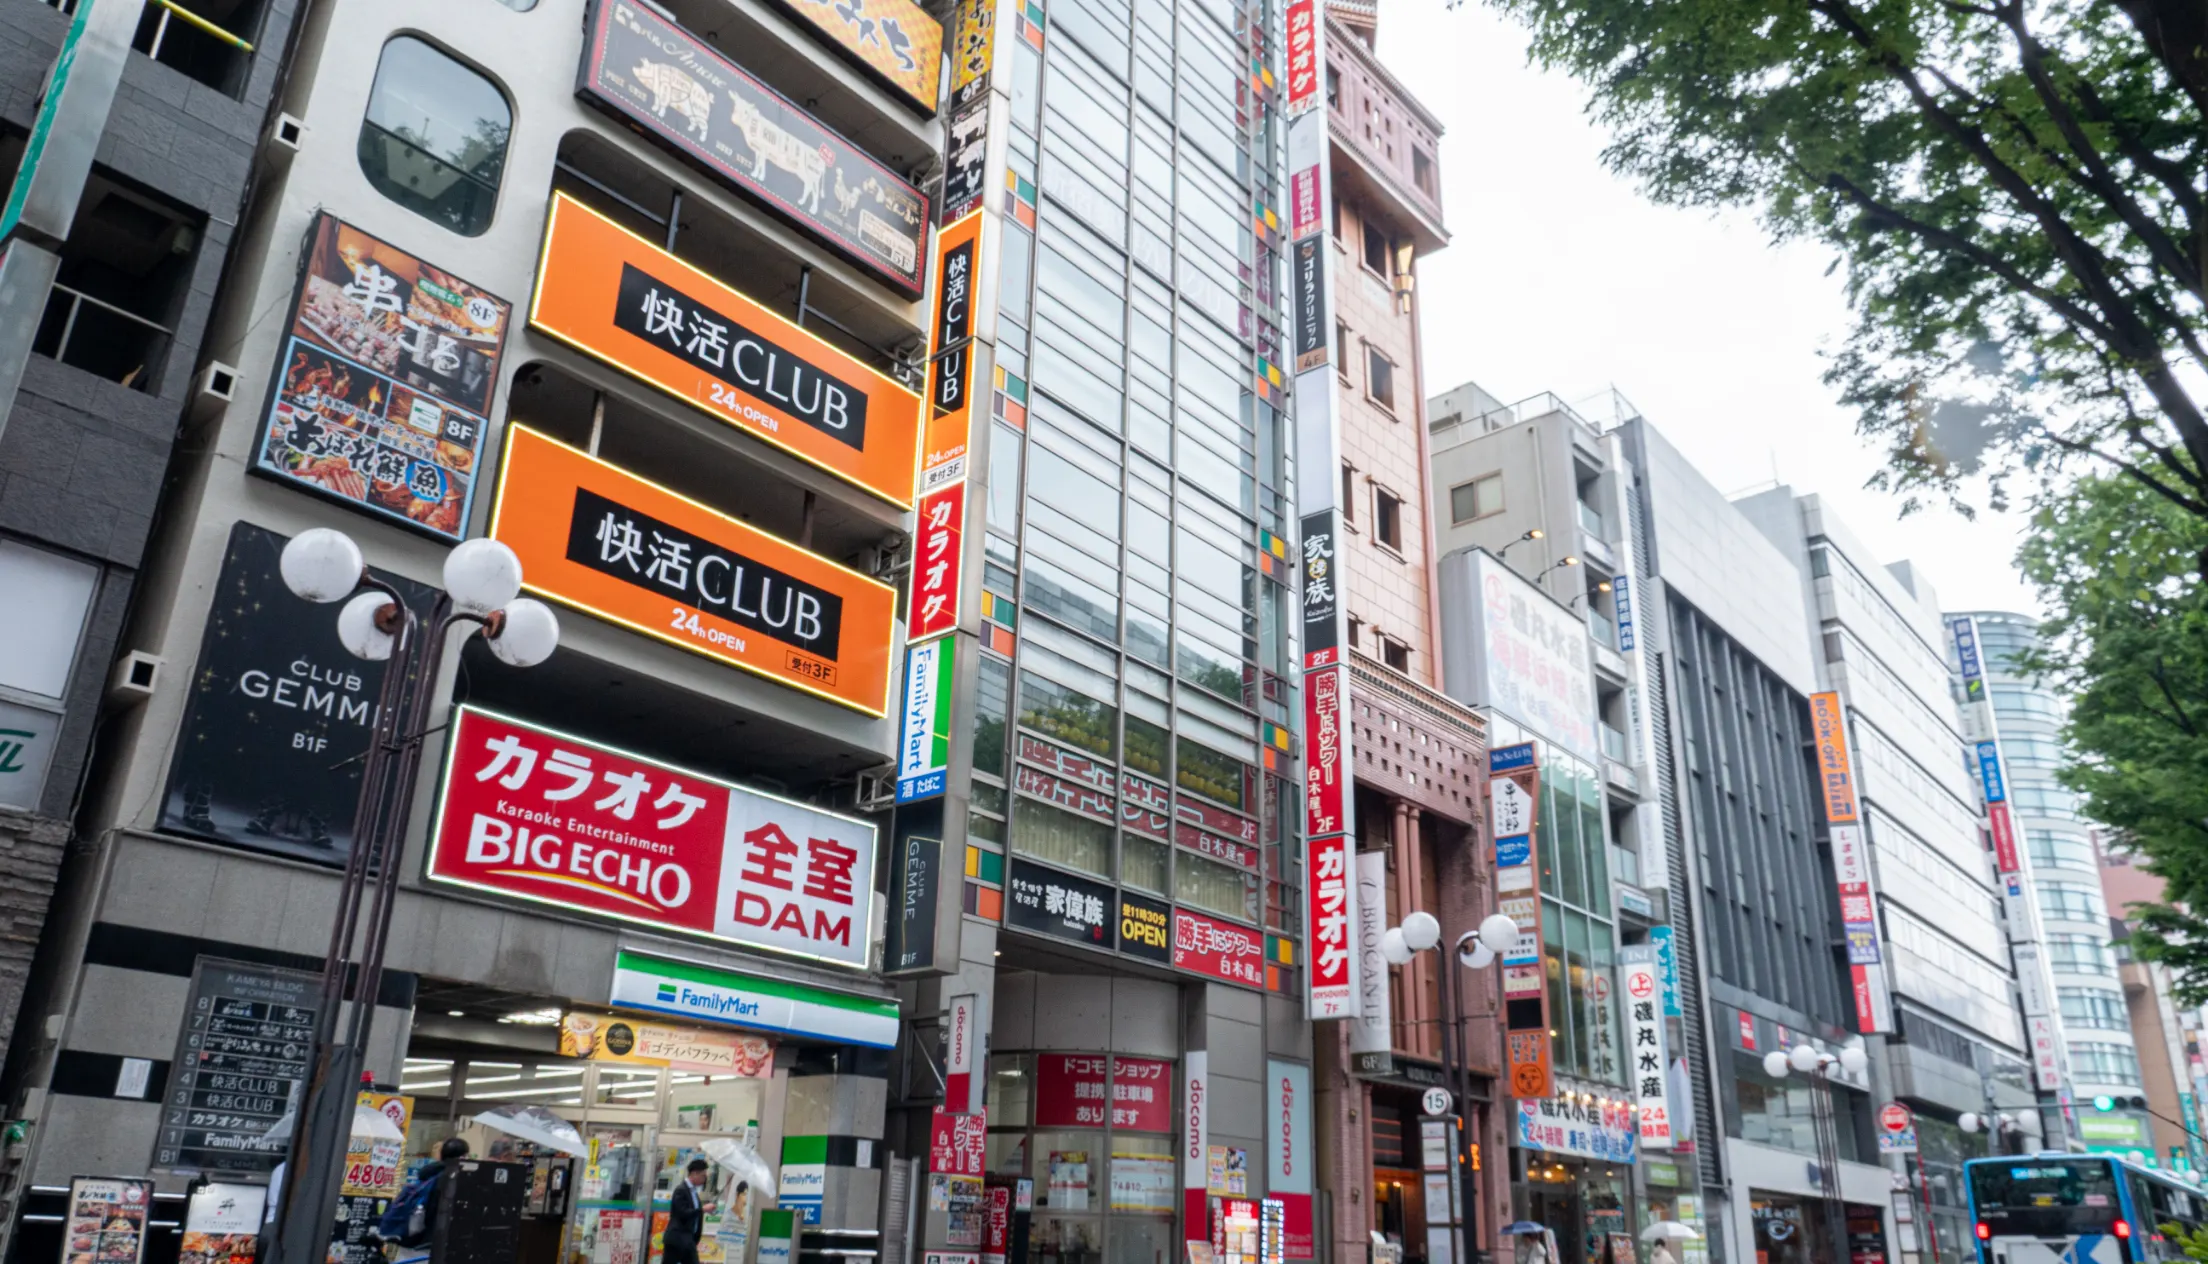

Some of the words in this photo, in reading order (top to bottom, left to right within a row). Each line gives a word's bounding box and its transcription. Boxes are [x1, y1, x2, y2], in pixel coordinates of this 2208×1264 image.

[1292, 11, 1313, 92] カラオケ
[961, 76, 982, 102] 6F
[470, 302, 495, 321] 8F
[1303, 258, 1317, 349] ゴリラクリニック
[943, 253, 967, 404] 快活CLUB
[641, 287, 850, 431] 快活CLUB
[1304, 354, 1321, 369] 4F
[446, 420, 474, 442] 8F
[743, 406, 779, 433] OPEN
[943, 443, 966, 461] OPEN
[921, 501, 952, 623] カラオケ
[596, 511, 824, 643] 快活CLUB
[707, 627, 747, 653] OPEN
[790, 655, 834, 681] 受付3F
[1312, 651, 1331, 666] 2F
[291, 660, 362, 692] CLUB
[240, 669, 391, 732] GEMM
[908, 646, 933, 770] FamilyMart
[1316, 671, 1339, 786] 勝手にサワー
[292, 732, 328, 754] B1F
[475, 734, 707, 831] カラオケ
[902, 779, 915, 800] 酒
[916, 775, 942, 795] たばこ
[1308, 766, 1322, 810] 白木屋
[496, 799, 562, 829] Karaoke
[567, 816, 676, 857] Entertainment
[1240, 819, 1257, 841] 2F
[1316, 815, 1335, 834] 2F
[465, 813, 564, 869] BIG
[570, 840, 692, 909] ECHO
[740, 821, 857, 907] 全室
[907, 840, 922, 920] GEMME
[1045, 884, 1104, 927] 家偉族
[1317, 847, 1348, 978] カラオケ
[733, 891, 852, 948] DAM
[1121, 919, 1167, 949] OPEN
[1176, 914, 1262, 957] 勝手にサワー
[902, 952, 917, 967] B1F
[1175, 951, 1185, 963] 2F
[1362, 907, 1382, 1027] BROCANTE
[197, 996, 208, 1010] 8
[681, 987, 759, 1017] FamilyMart
[1324, 1002, 1340, 1015] 7F
[194, 1015, 204, 1027] 7
[189, 1035, 200, 1048] 6
[954, 1006, 966, 1065] docomo
[185, 1053, 196, 1066] 5
[1634, 1000, 1663, 1098] 磯丸水産
[1064, 1058, 1162, 1079] ドコモショップ
[1361, 1055, 1380, 1070] 6F
[180, 1072, 190, 1085] 4
[210, 1074, 279, 1094] 快活CLUB
[176, 1091, 187, 1104] 3
[206, 1094, 275, 1112] 快活CLUB
[1075, 1082, 1153, 1103] 提携駐車場
[1427, 1093, 1445, 1109] 15
[171, 1111, 182, 1123] 2
[191, 1113, 244, 1128] カラオケ
[1076, 1106, 1139, 1125] あります
[1190, 1079, 1204, 1159] docomo
[1641, 1106, 1666, 1121] 24
[168, 1131, 176, 1142] 1
[1281, 1077, 1294, 1177] docomo
[1641, 1123, 1670, 1138] 時間
[204, 1132, 279, 1151] FamilyMart
[160, 1150, 177, 1163] B1
[782, 1174, 823, 1186] FamilyMart
[991, 1186, 1009, 1247] 勝手に
